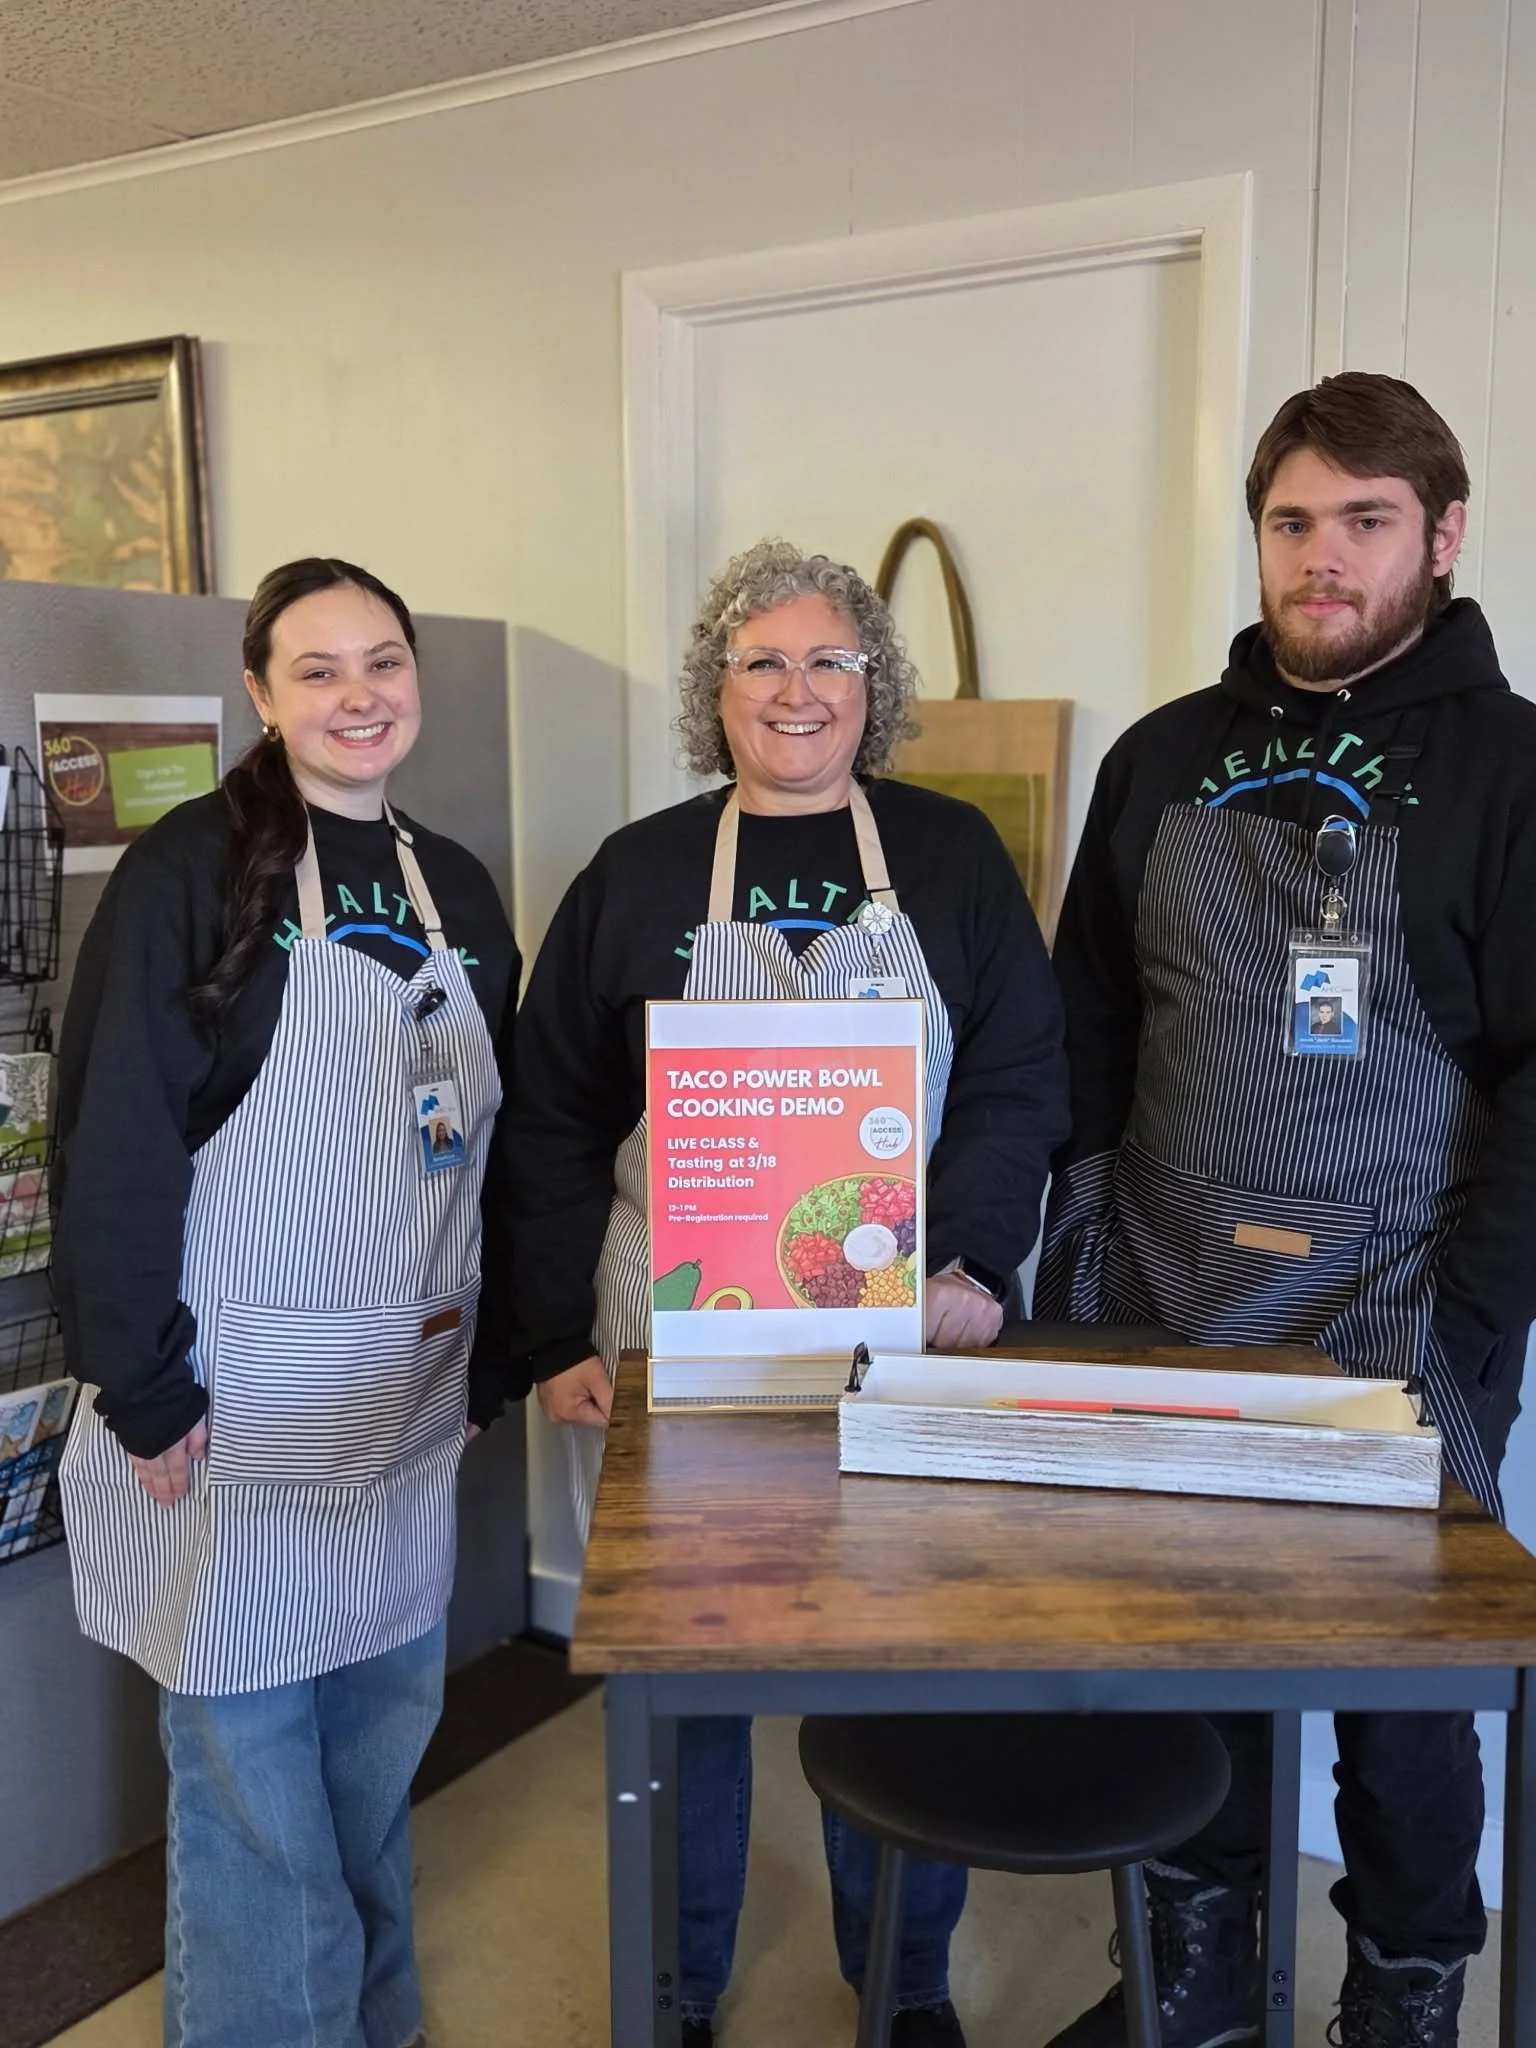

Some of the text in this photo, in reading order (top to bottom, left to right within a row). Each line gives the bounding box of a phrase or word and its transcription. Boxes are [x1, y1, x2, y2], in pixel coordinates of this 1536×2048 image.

[43, 736, 71, 757] 360
[53, 753, 98, 773] ACCESS
[667, 1068, 883, 1089] TACO POWER BOWL
[667, 1097, 844, 1118] COOKING DEMO
[868, 1117, 887, 1125] 360
[668, 1137, 759, 1150] LIVE CLASS &
[873, 1135, 898, 1150] Hub
[668, 1154, 776, 1172] Tasting at 3/18
[668, 1176, 754, 1189] Distribution
[668, 1204, 683, 1212] 12-1
[668, 1213, 769, 1223] Pre-Registration required
